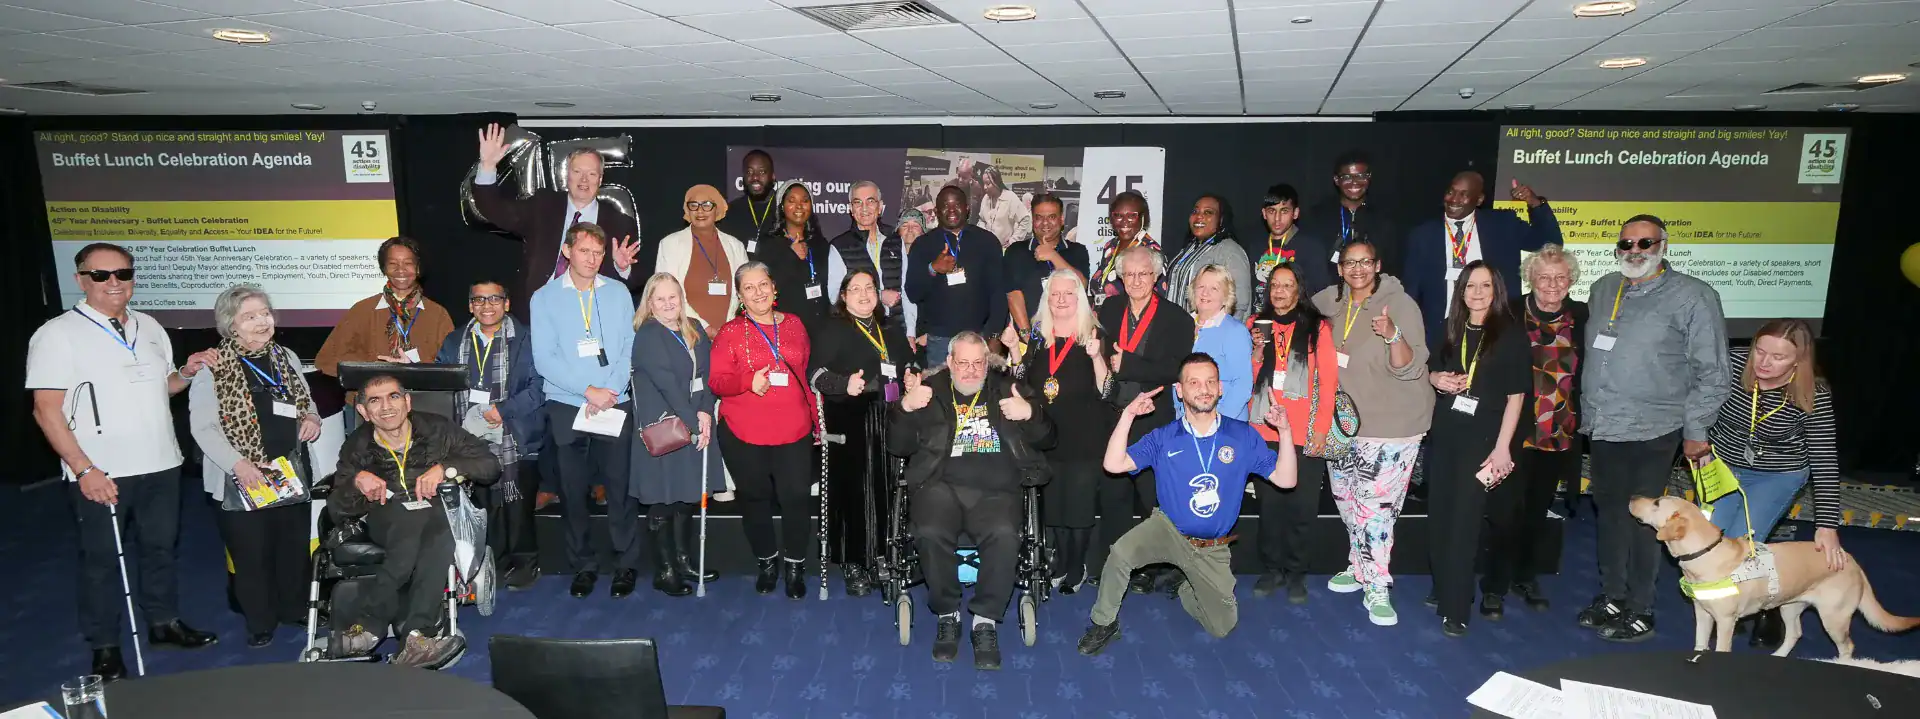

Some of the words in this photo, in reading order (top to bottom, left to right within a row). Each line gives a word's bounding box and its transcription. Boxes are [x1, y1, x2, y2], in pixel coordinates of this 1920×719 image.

[40, 132, 51, 142] All
[54, 132, 77, 143] right,
[80, 132, 108, 143] good?
[111, 132, 139, 142] Stand
[142, 135, 153, 144] up
[156, 132, 175, 142] nice
[177, 132, 195, 142] and
[198, 132, 232, 143] straight
[234, 132, 251, 142] and
[253, 132, 268, 143] big
[270, 131, 302, 142] smiles!
[306, 131, 325, 143] Yay!
[1507, 129, 1518, 138] All
[1521, 129, 1543, 139] right,
[1545, 129, 1575, 139] good?
[1577, 129, 1604, 138] Stand
[1607, 131, 1618, 140] up
[1622, 129, 1640, 138] nice
[1642, 129, 1660, 138] and
[1662, 129, 1696, 140] straight
[1698, 129, 1716, 138] and
[1718, 129, 1731, 141] big
[1733, 129, 1766, 138] smiles!
[1768, 130, 1788, 141] Yay!
[350, 140, 378, 158] 45
[1808, 139, 1836, 158] 45
[52, 152, 101, 167] Buffet
[104, 152, 154, 167] Lunch
[157, 152, 248, 167] Celebration
[252, 152, 312, 169] Agenda
[1513, 149, 1562, 165] Buffet
[1565, 149, 1613, 165] Lunch
[1618, 149, 1706, 165] Celebration
[1709, 150, 1769, 168] Agenda
[826, 182, 851, 193] our
[92, 206, 130, 214] Disability
[1552, 207, 1578, 215] ability
[91, 217, 139, 226] Anniversary
[54, 228, 93, 236] Celebrating
[160, 228, 187, 236] Equality
[1569, 231, 1600, 239] Diversity,
[213, 255, 252, 263] Anniversary
[172, 264, 196, 272] Deputy
[198, 264, 218, 272] Mayor
[1739, 260, 1761, 268] variety
[1771, 260, 1801, 268] speakers,
[168, 273, 193, 281] sharing
[226, 273, 254, 281] journeys
[1707, 279, 1733, 287] oyment,
[1778, 279, 1813, 287] Payments,
